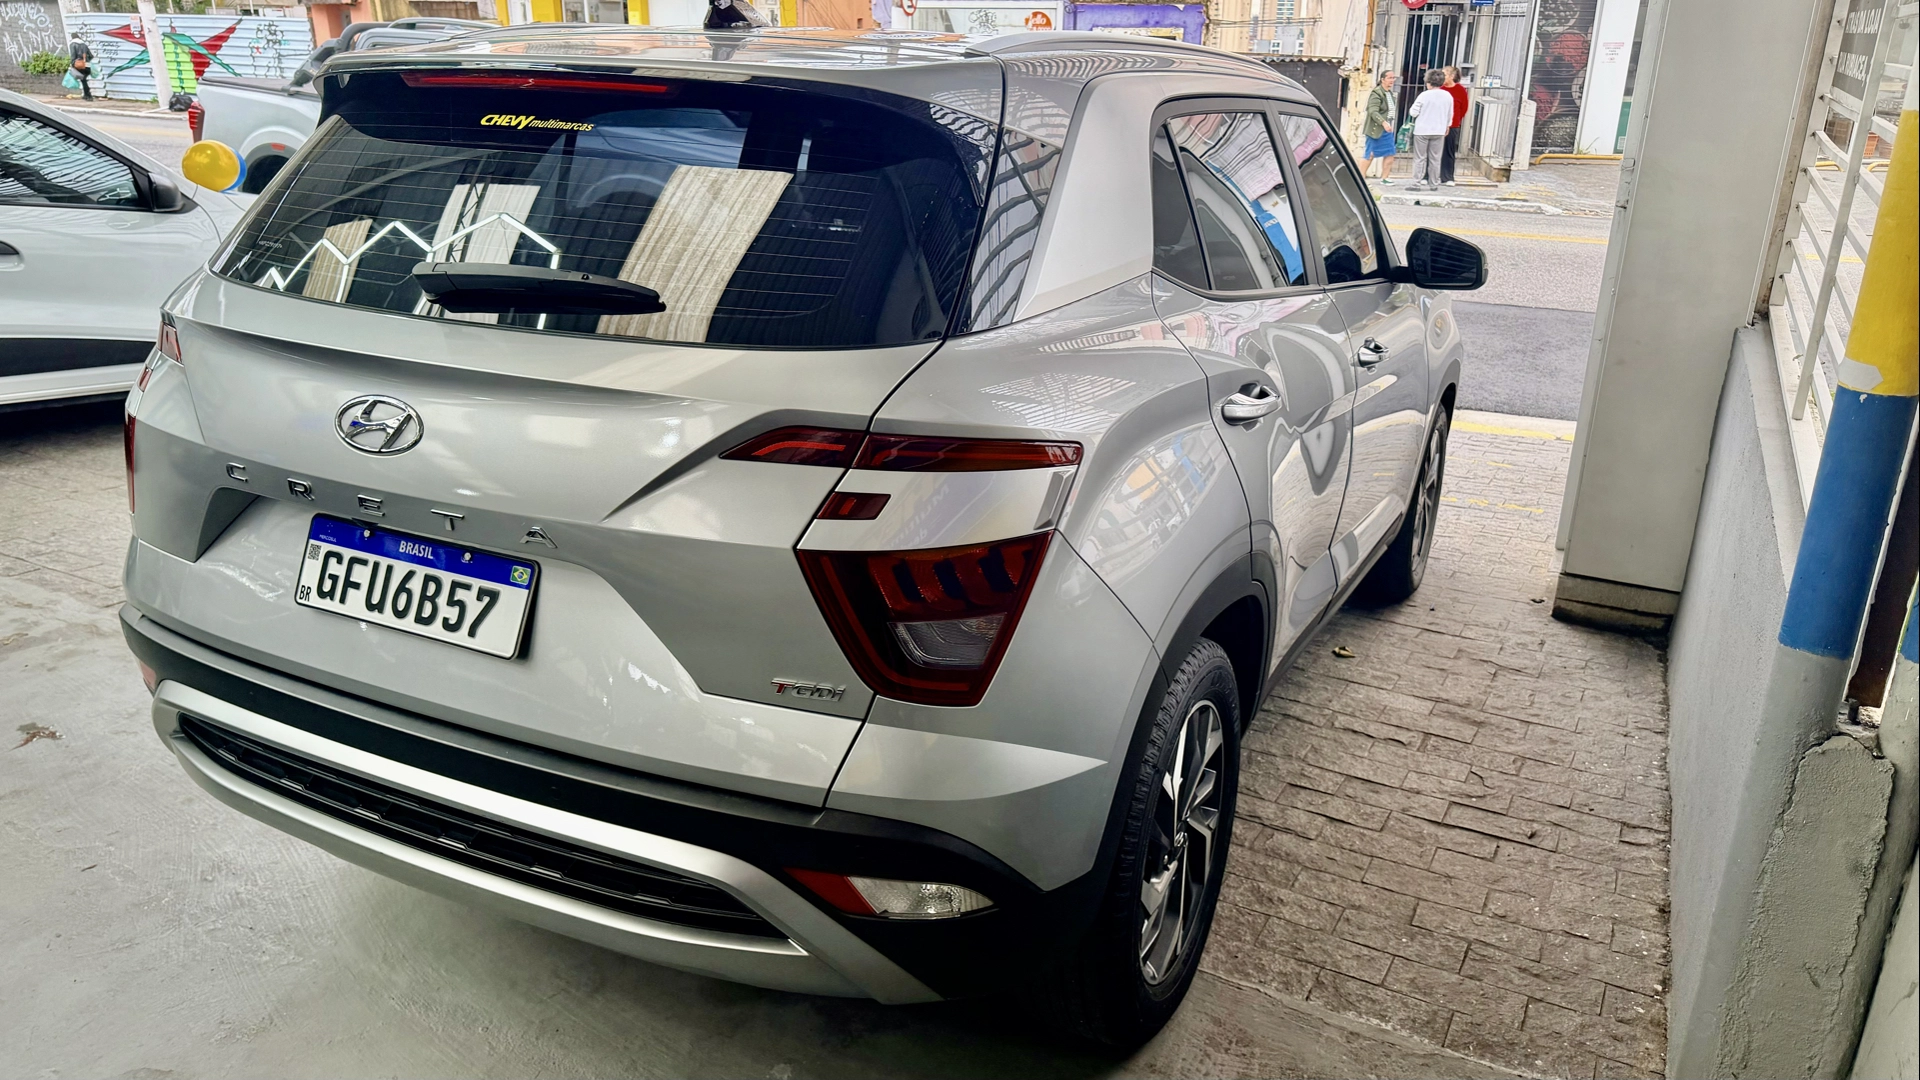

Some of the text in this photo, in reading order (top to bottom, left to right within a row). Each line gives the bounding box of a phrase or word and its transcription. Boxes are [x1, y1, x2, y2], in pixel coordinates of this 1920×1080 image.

[1864, 8, 1881, 34] LOJA
[480, 114, 595, 131] CHEVY multimarcas
[225, 462, 558, 549] CRETA
[399, 540, 434, 559] BRASIL
[299, 584, 312, 602] BR
[316, 550, 501, 638] GFU6B57
[771, 678, 846, 702] TGDi
